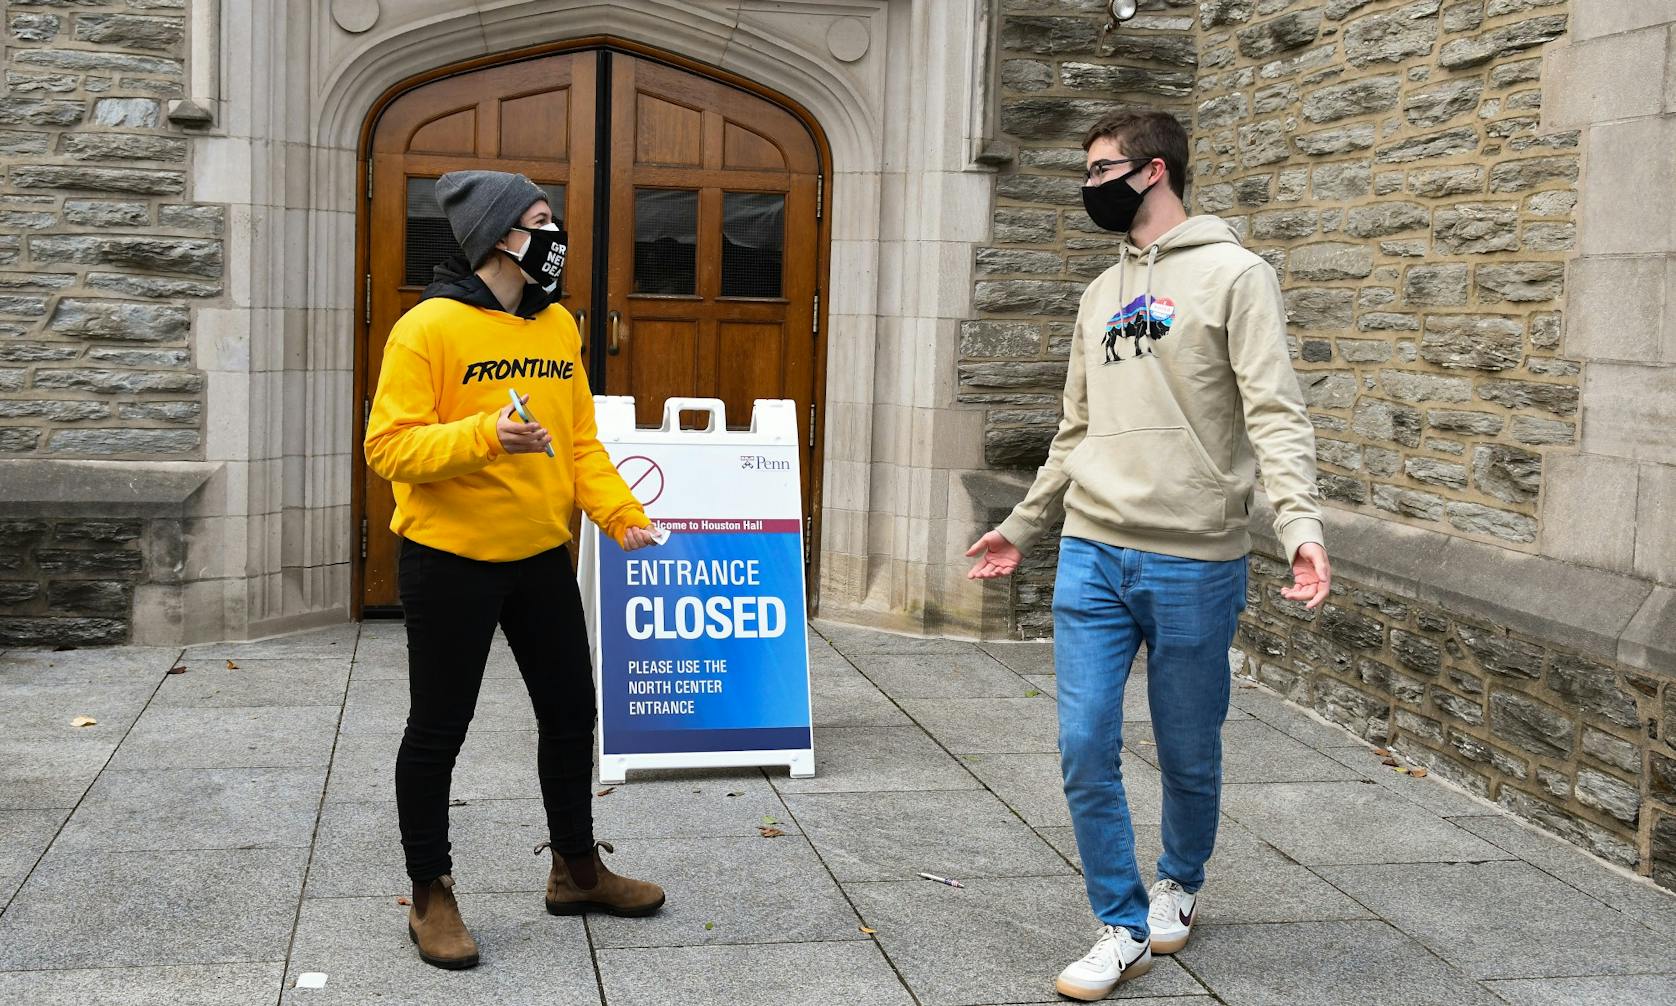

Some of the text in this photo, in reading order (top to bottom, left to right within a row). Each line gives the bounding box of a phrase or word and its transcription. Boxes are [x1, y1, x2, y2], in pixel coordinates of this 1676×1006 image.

[462, 357, 573, 385] FRONTLINE
[756, 455, 790, 470] Penn
[689, 521, 699, 530] to
[701, 520, 741, 530] Houston
[743, 520, 763, 530] Hall
[626, 559, 760, 586] ENTRANCE
[625, 596, 787, 640] CLOSED
[628, 659, 728, 674] PLEASE USE THE
[628, 679, 723, 695] NORTH CENTER
[629, 700, 695, 715] ENTRANCE
